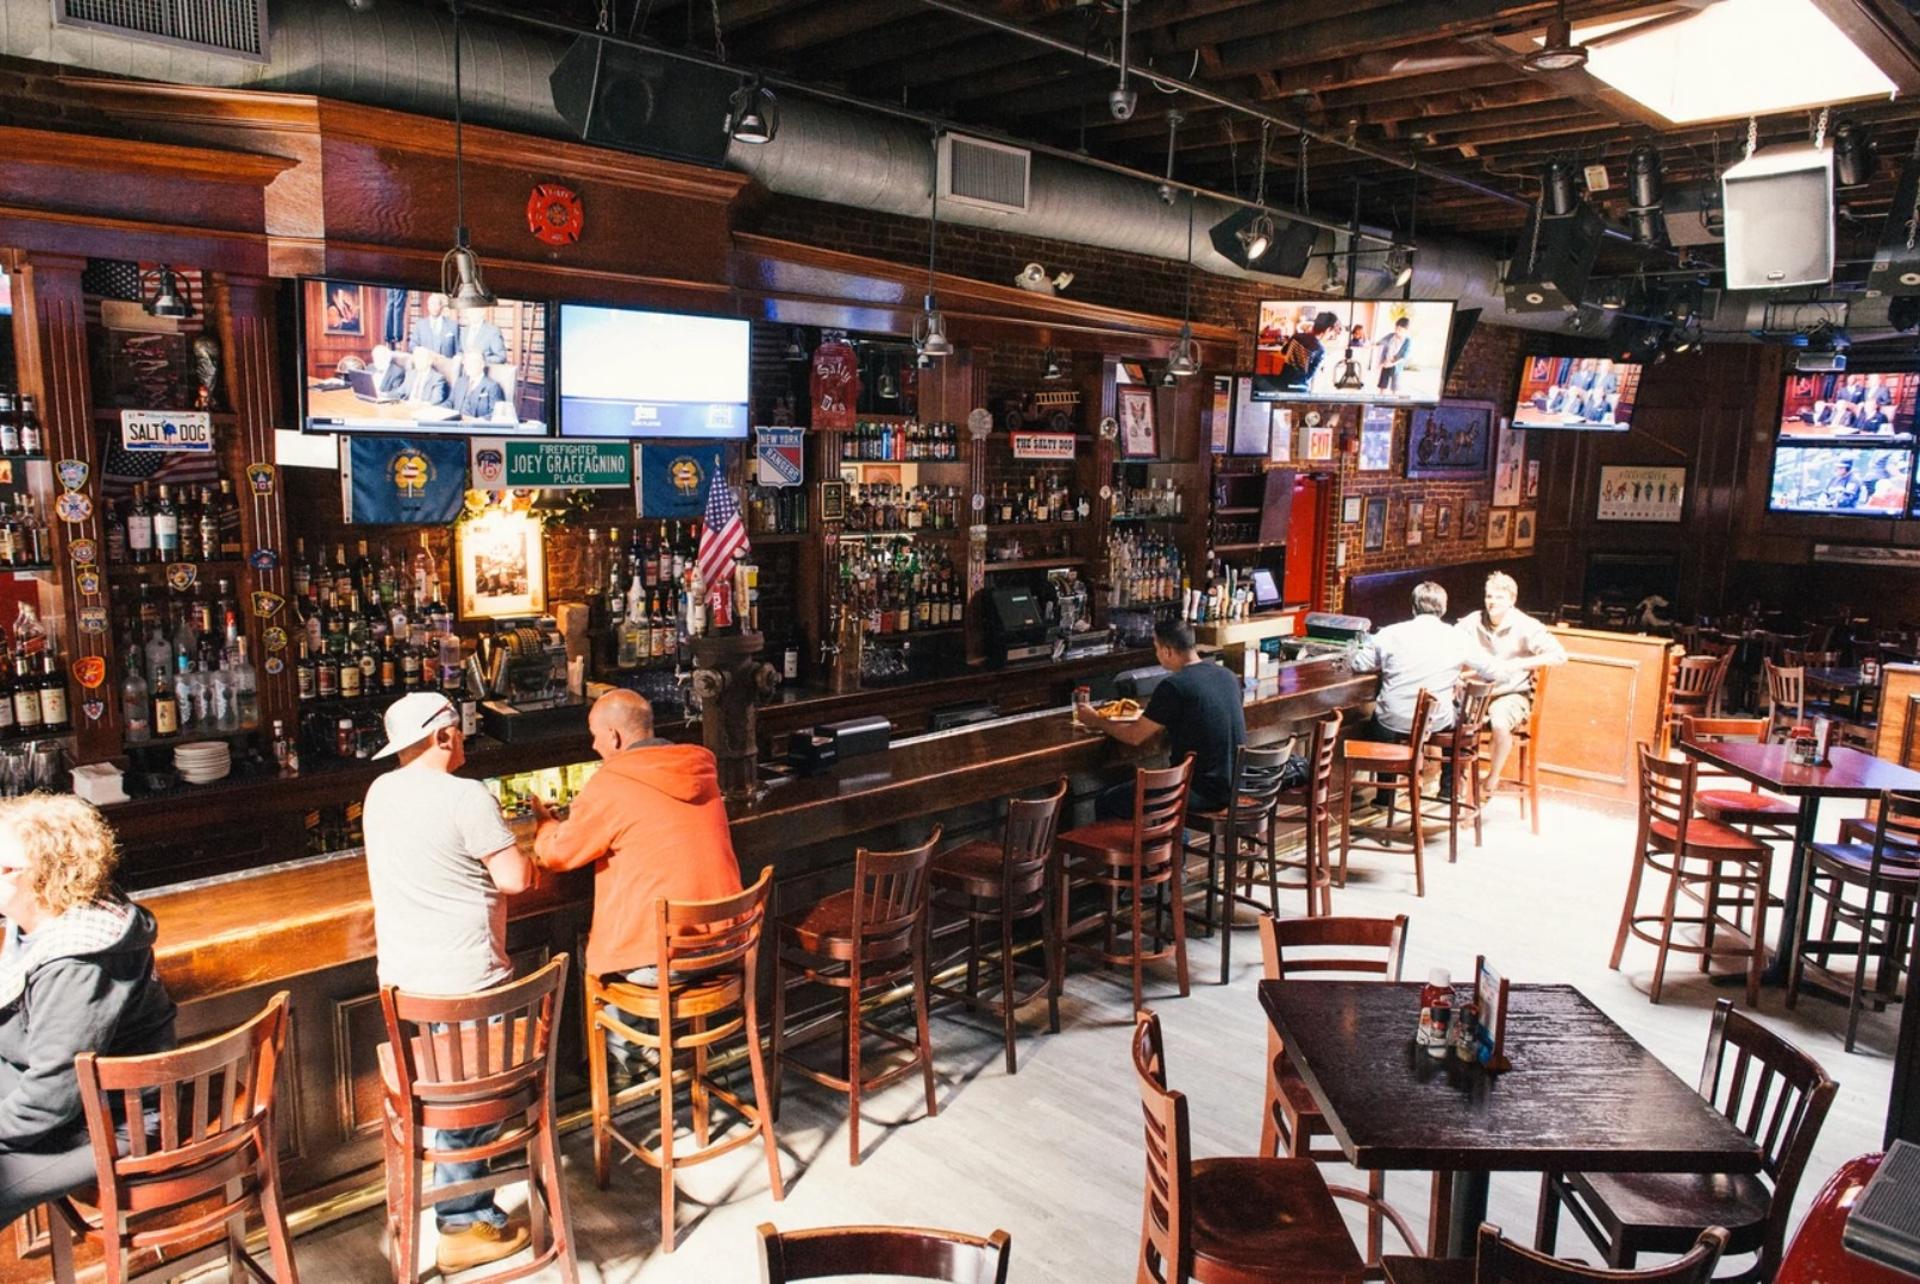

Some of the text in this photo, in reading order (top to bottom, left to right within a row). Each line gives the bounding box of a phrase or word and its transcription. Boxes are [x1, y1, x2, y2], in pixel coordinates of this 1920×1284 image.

[180, 424, 206, 441] DOG
[760, 434, 799, 444] NEW YORK
[1016, 438, 1073, 449] THE SALTY DOG
[539, 445, 598, 454] FIREFIGHTER
[511, 454, 542, 473] JOEY
[546, 454, 625, 473] GRAFFAGNINO
[765, 447, 799, 481] RANGERS
[553, 474, 585, 483] PLACE
